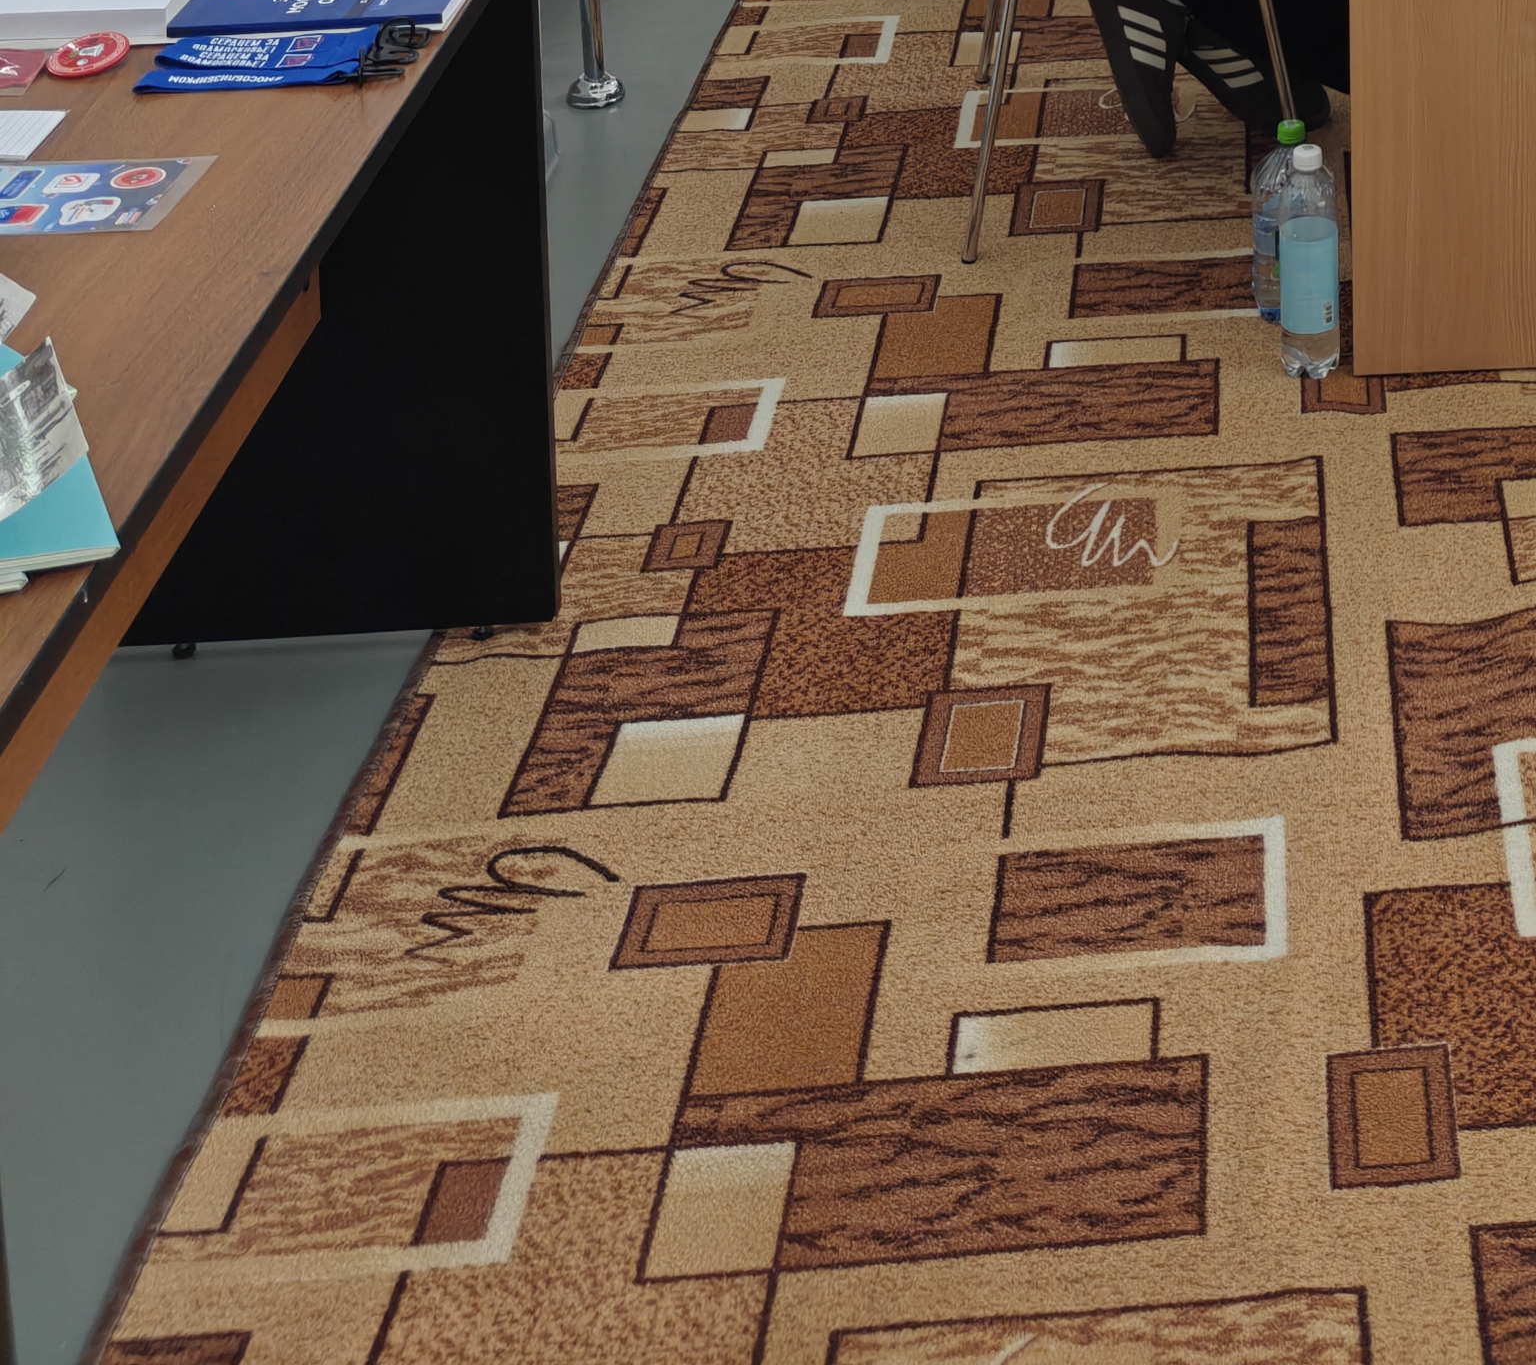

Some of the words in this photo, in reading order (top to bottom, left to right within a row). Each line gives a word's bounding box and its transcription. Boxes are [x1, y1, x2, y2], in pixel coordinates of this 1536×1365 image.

[210, 37, 262, 47] СЕРДЦЕМ
[265, 38, 281, 46] ЗА
[199, 51, 251, 61] СЕРДЦЕМ
[254, 53, 270, 61] ЗА
